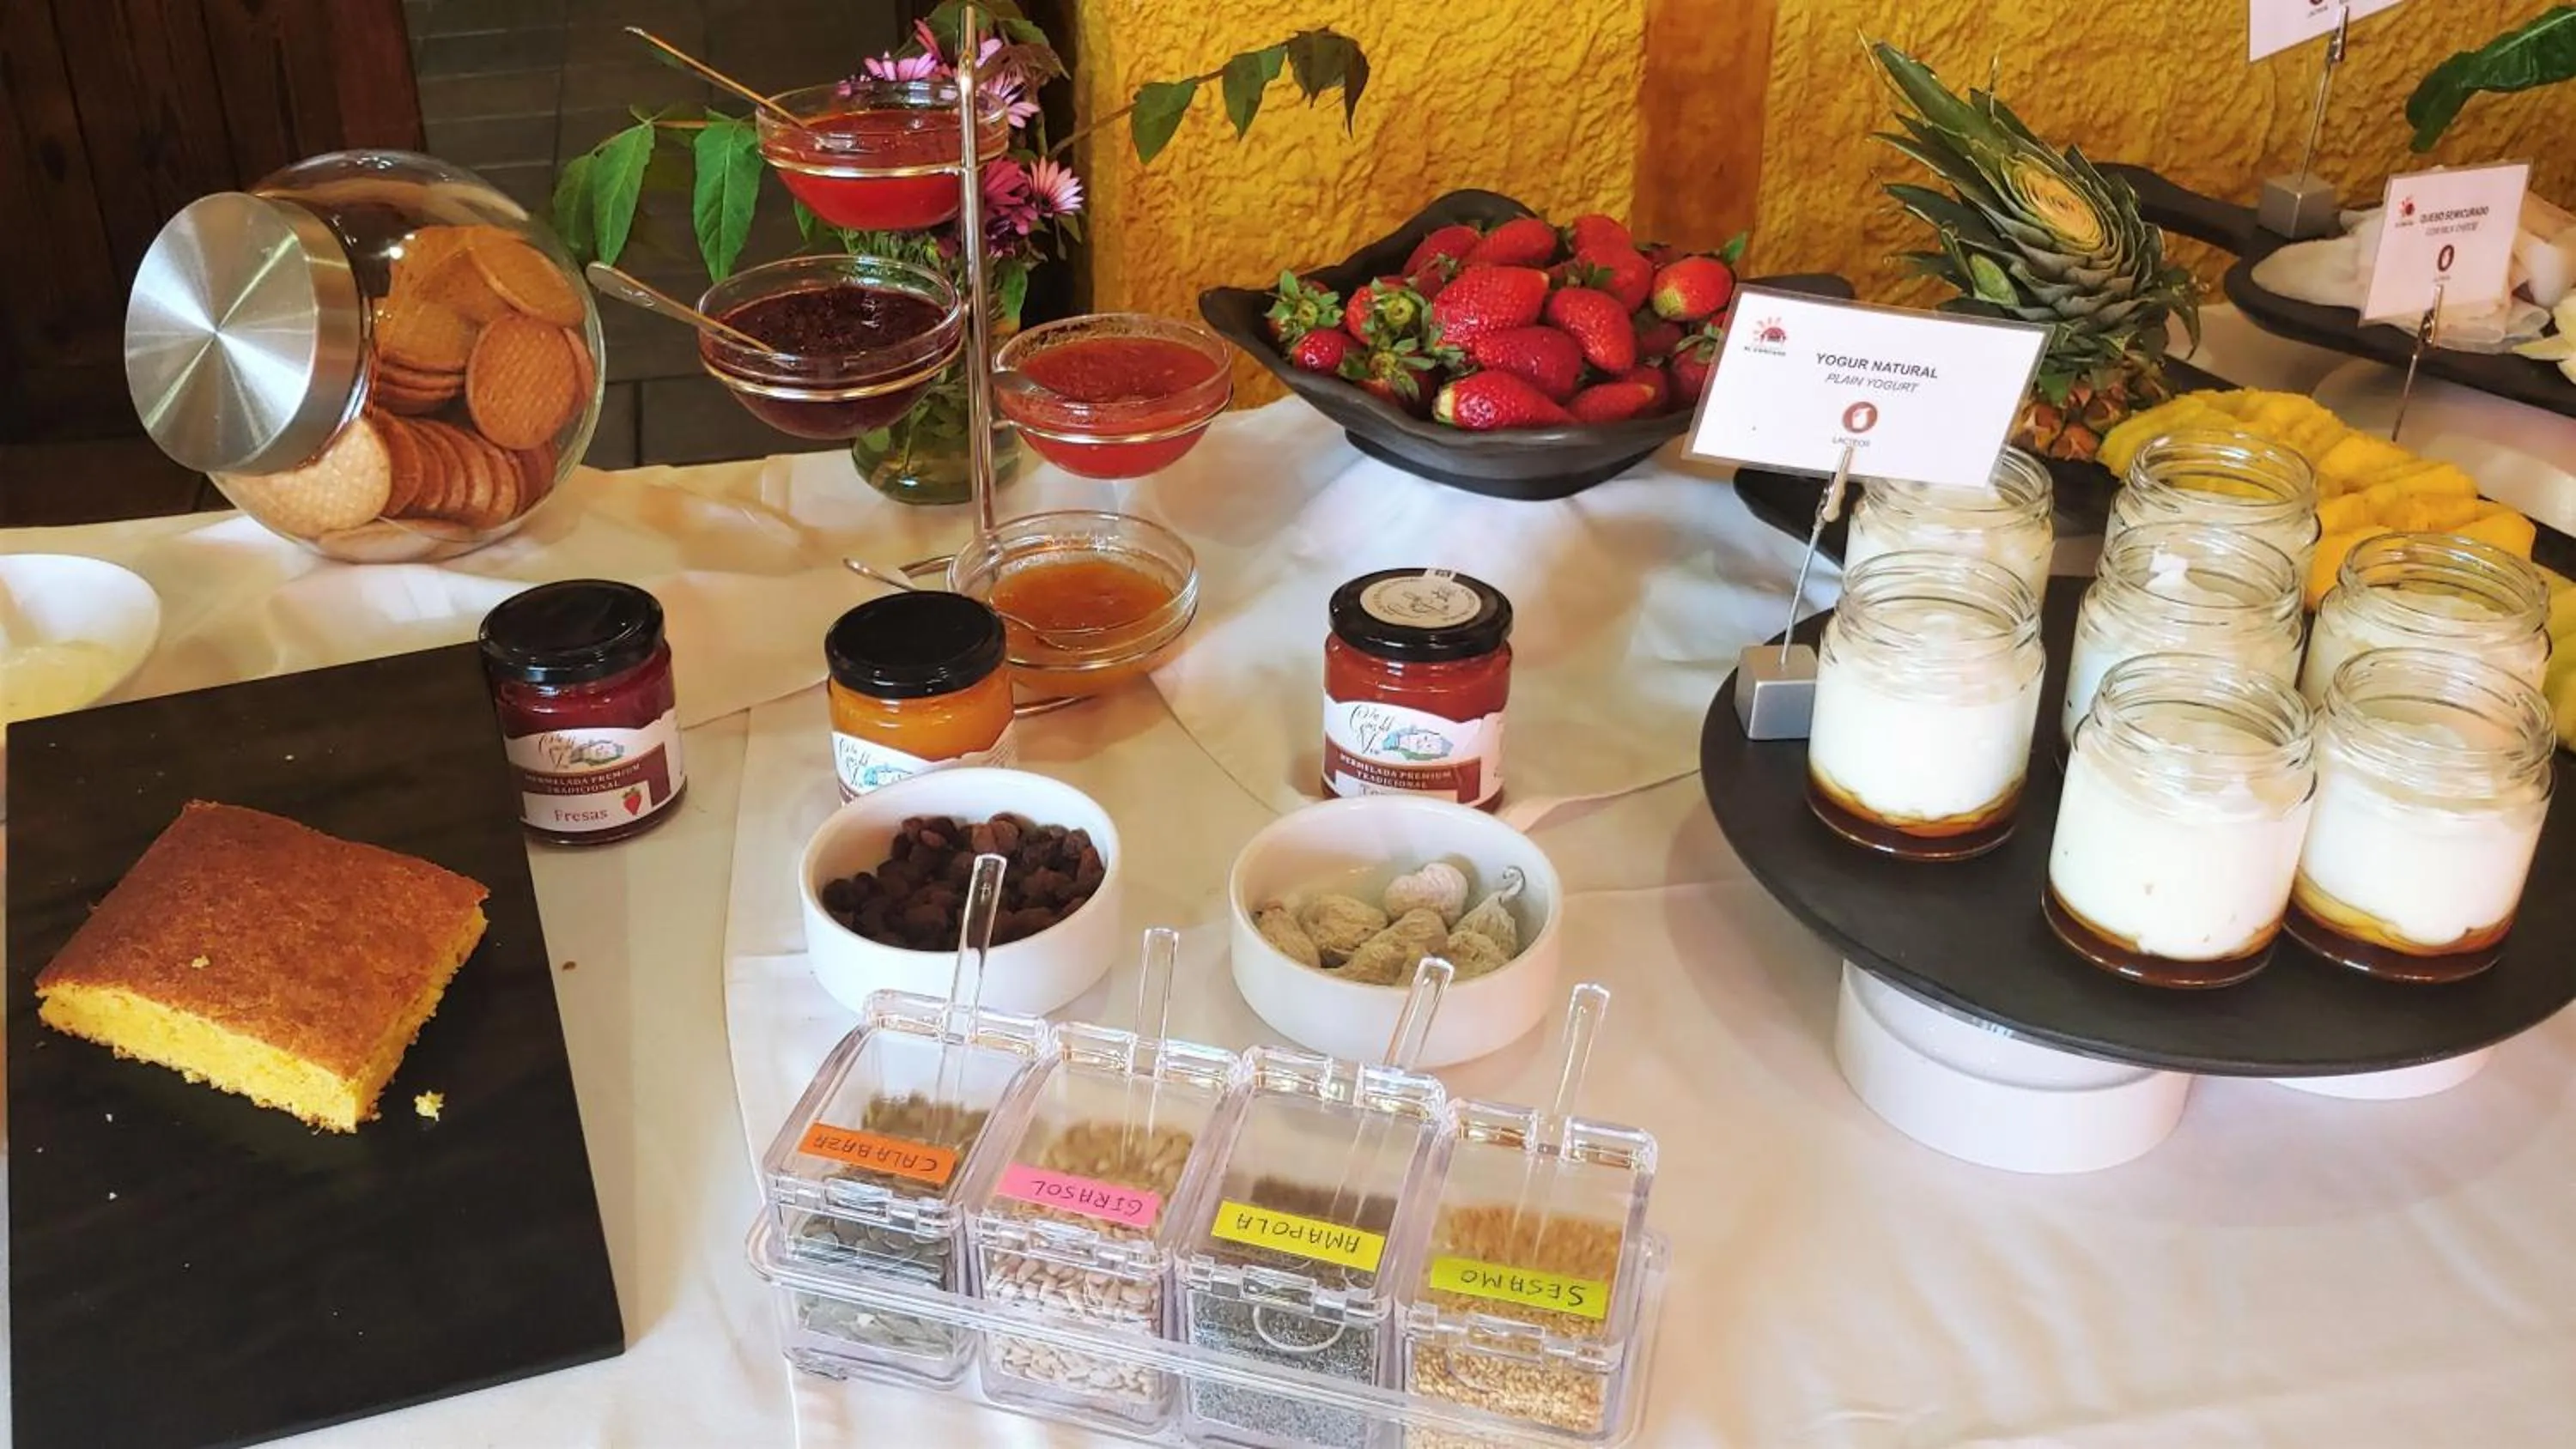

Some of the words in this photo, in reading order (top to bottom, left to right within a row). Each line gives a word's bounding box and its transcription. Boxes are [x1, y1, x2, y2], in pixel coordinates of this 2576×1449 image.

[1816, 353, 1868, 370] YOGUR
[1871, 360, 1938, 379] NATURAL
[1826, 373, 1864, 385] PLAIN
[1867, 379, 1920, 393] YOGURT
[1357, 769, 1428, 789] TRADICIONAL
[1400, 770, 1453, 780] PREMIUM
[554, 809, 608, 822] Fresas
[1030, 1180, 1143, 1216] GIRASOL
[1236, 1212, 1361, 1253] AMAPOLA
[1460, 1270, 1587, 1307] SESAMO
